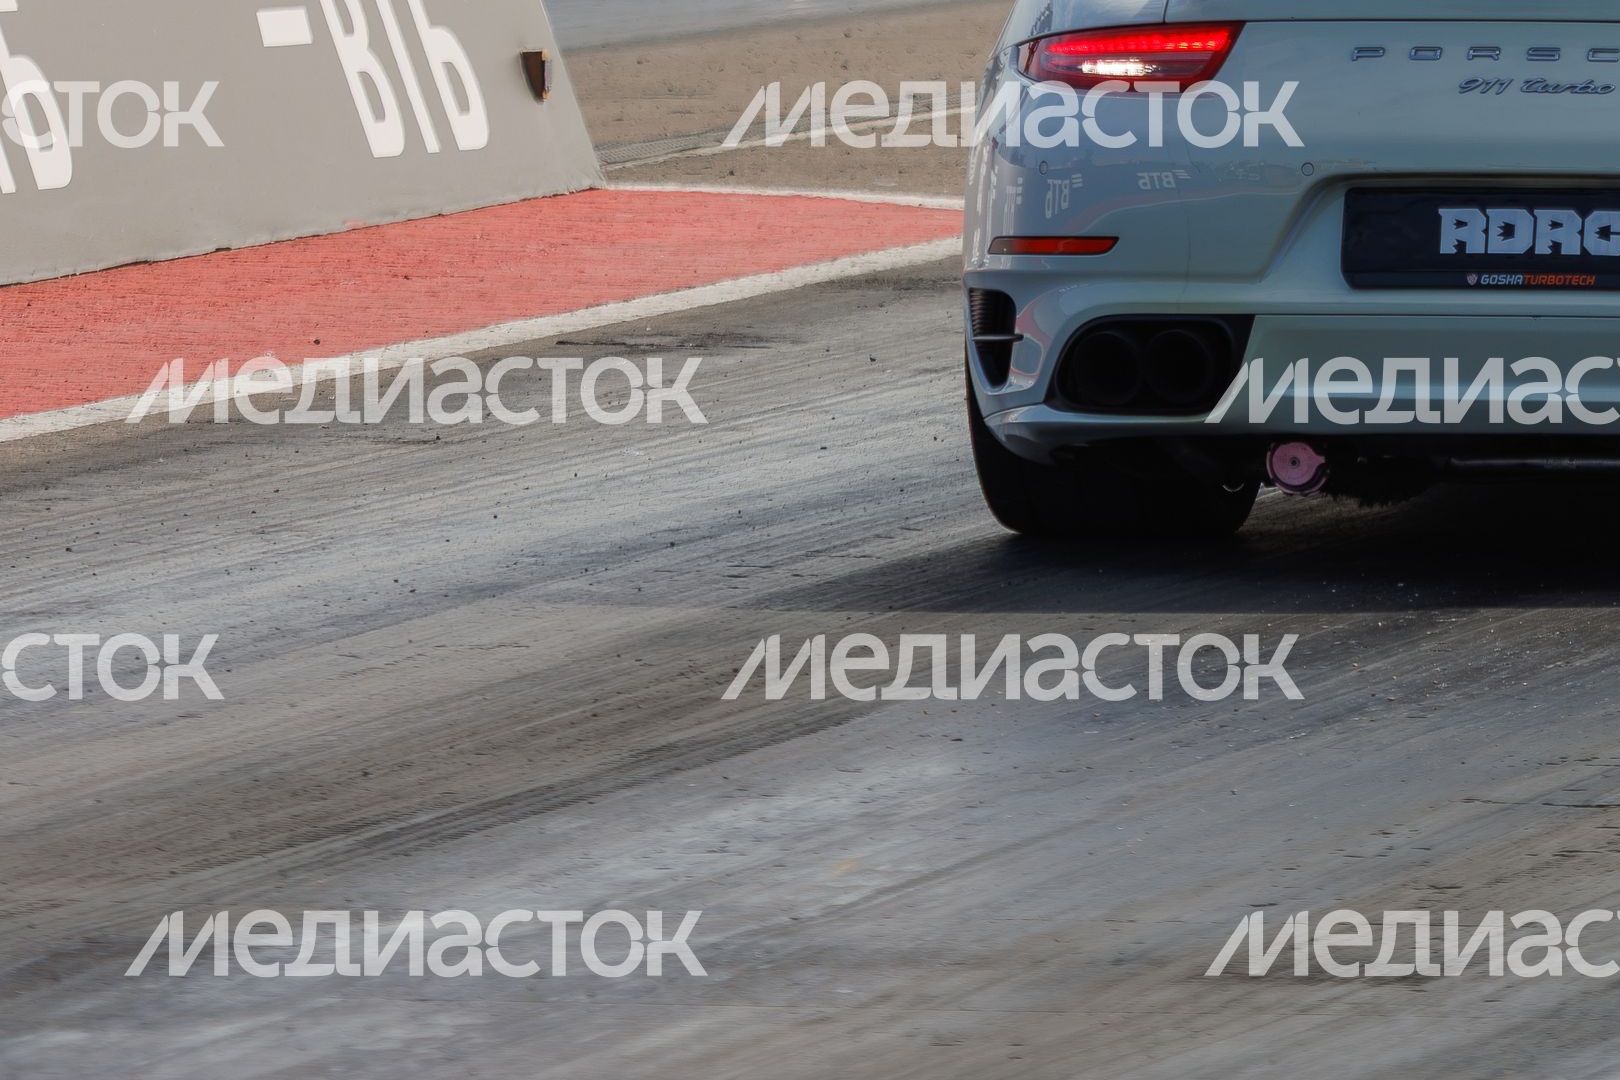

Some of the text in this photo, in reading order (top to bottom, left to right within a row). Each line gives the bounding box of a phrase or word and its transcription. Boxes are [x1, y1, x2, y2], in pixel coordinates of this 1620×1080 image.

[1458, 77, 1617, 95] 911 turbo
[1480, 274, 1596, 286] GOSHATURBOTECH
